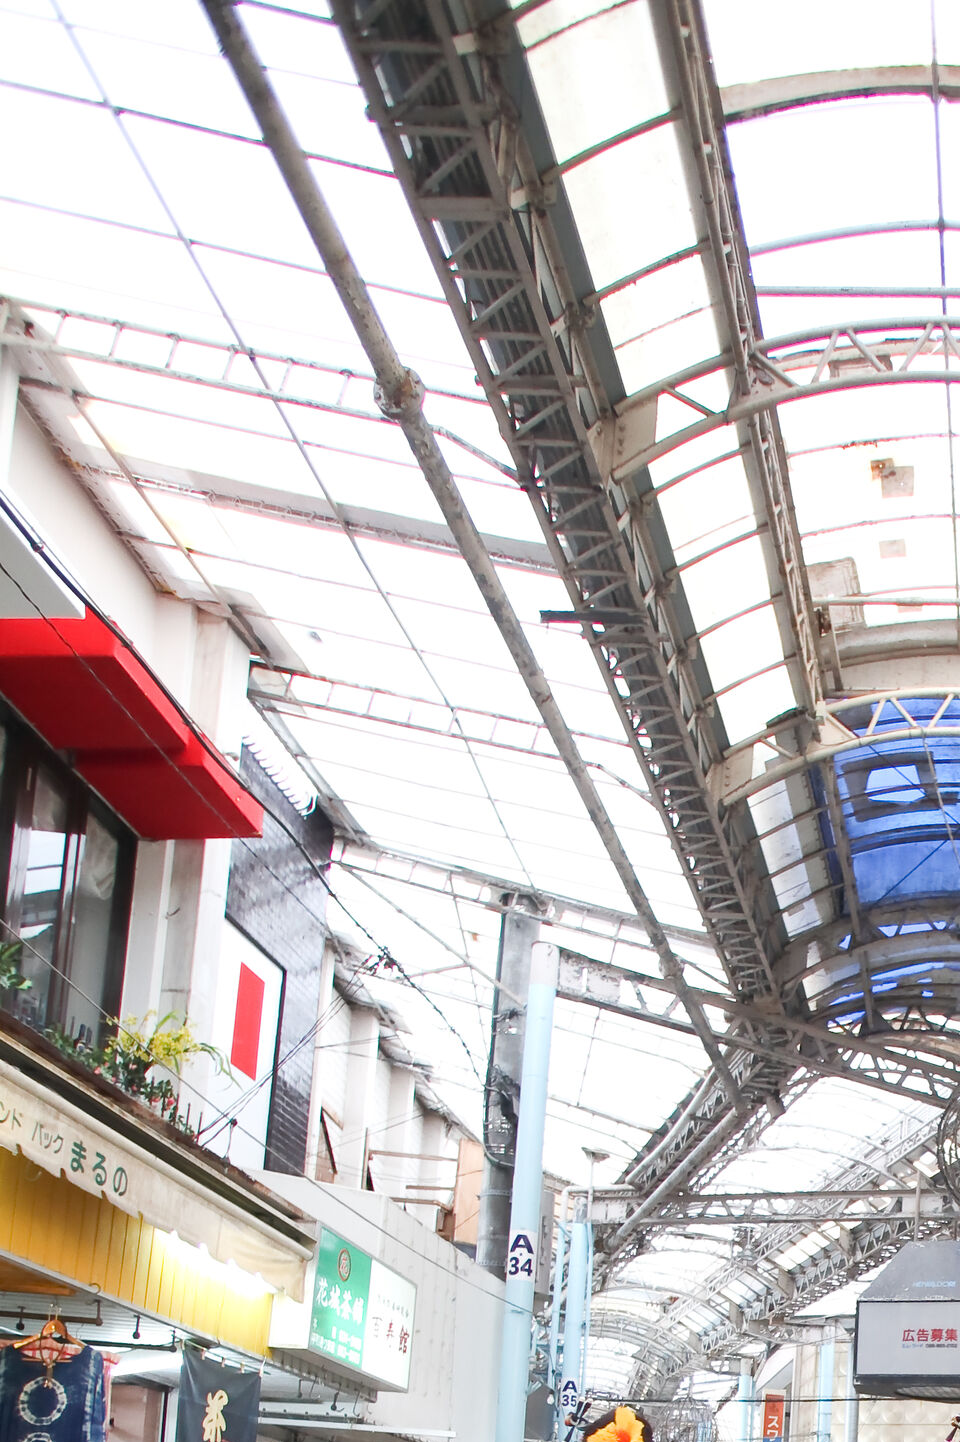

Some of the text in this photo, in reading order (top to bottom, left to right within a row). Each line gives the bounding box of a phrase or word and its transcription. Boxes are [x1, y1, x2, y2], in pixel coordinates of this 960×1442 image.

[70, 1141, 129, 1197] まるの
[510, 1234, 534, 1255] A
[508, 1256, 533, 1277] 34
[902, 1328, 958, 1343] 広告募集
[562, 1380, 578, 1393] A
[561, 1394, 577, 1407] 35
